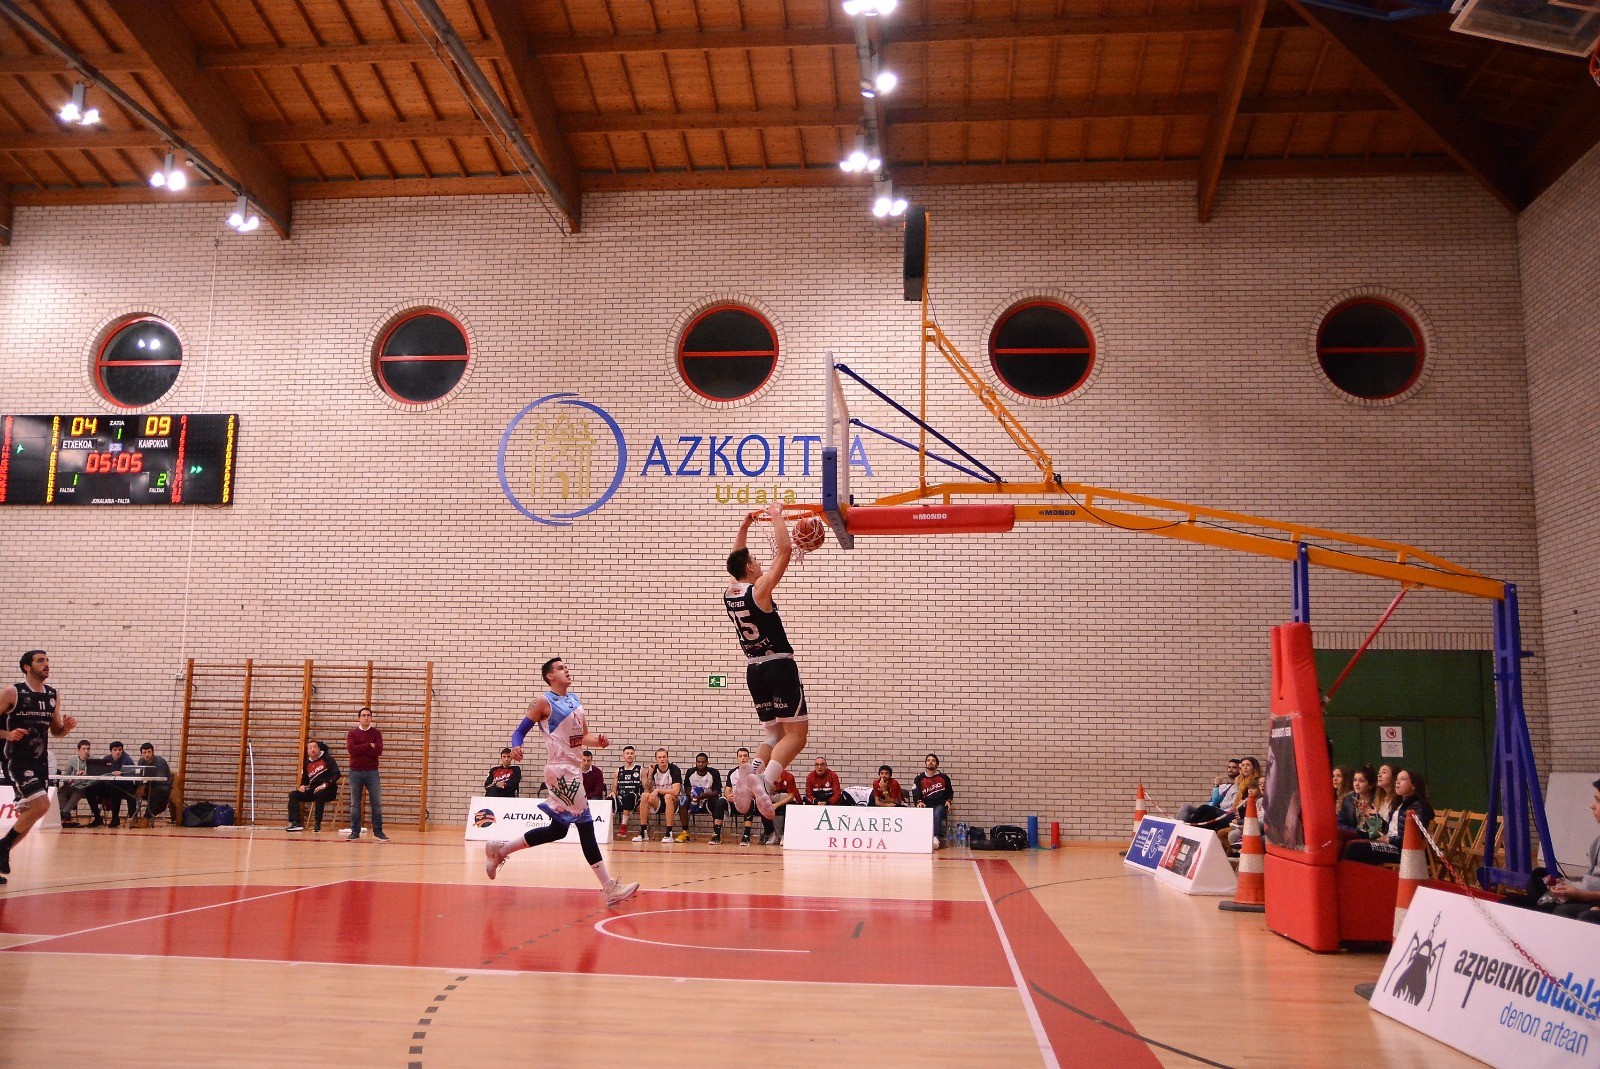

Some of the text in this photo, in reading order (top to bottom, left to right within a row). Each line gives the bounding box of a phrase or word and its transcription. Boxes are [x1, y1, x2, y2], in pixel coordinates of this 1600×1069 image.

[71, 416, 98, 436] 04
[117, 428, 122, 440] 1
[145, 415, 172, 436] 09
[62, 440, 93, 449] ETXEKOA
[138, 439, 169, 448] KANPOKOA
[86, 452, 143, 473] 05:05
[640, 434, 874, 477] AZKOITA
[73, 473, 79, 487] 1
[157, 472, 167, 487] 2
[715, 484, 797, 504] Udala
[728, 609, 760, 641] 15
[38, 700, 46, 710] 11
[503, 813, 544, 821] ALTUNA
[814, 808, 903, 833] AÑARES
[828, 837, 888, 850] RIOJA
[1500, 1002, 1589, 1057] denon artean
